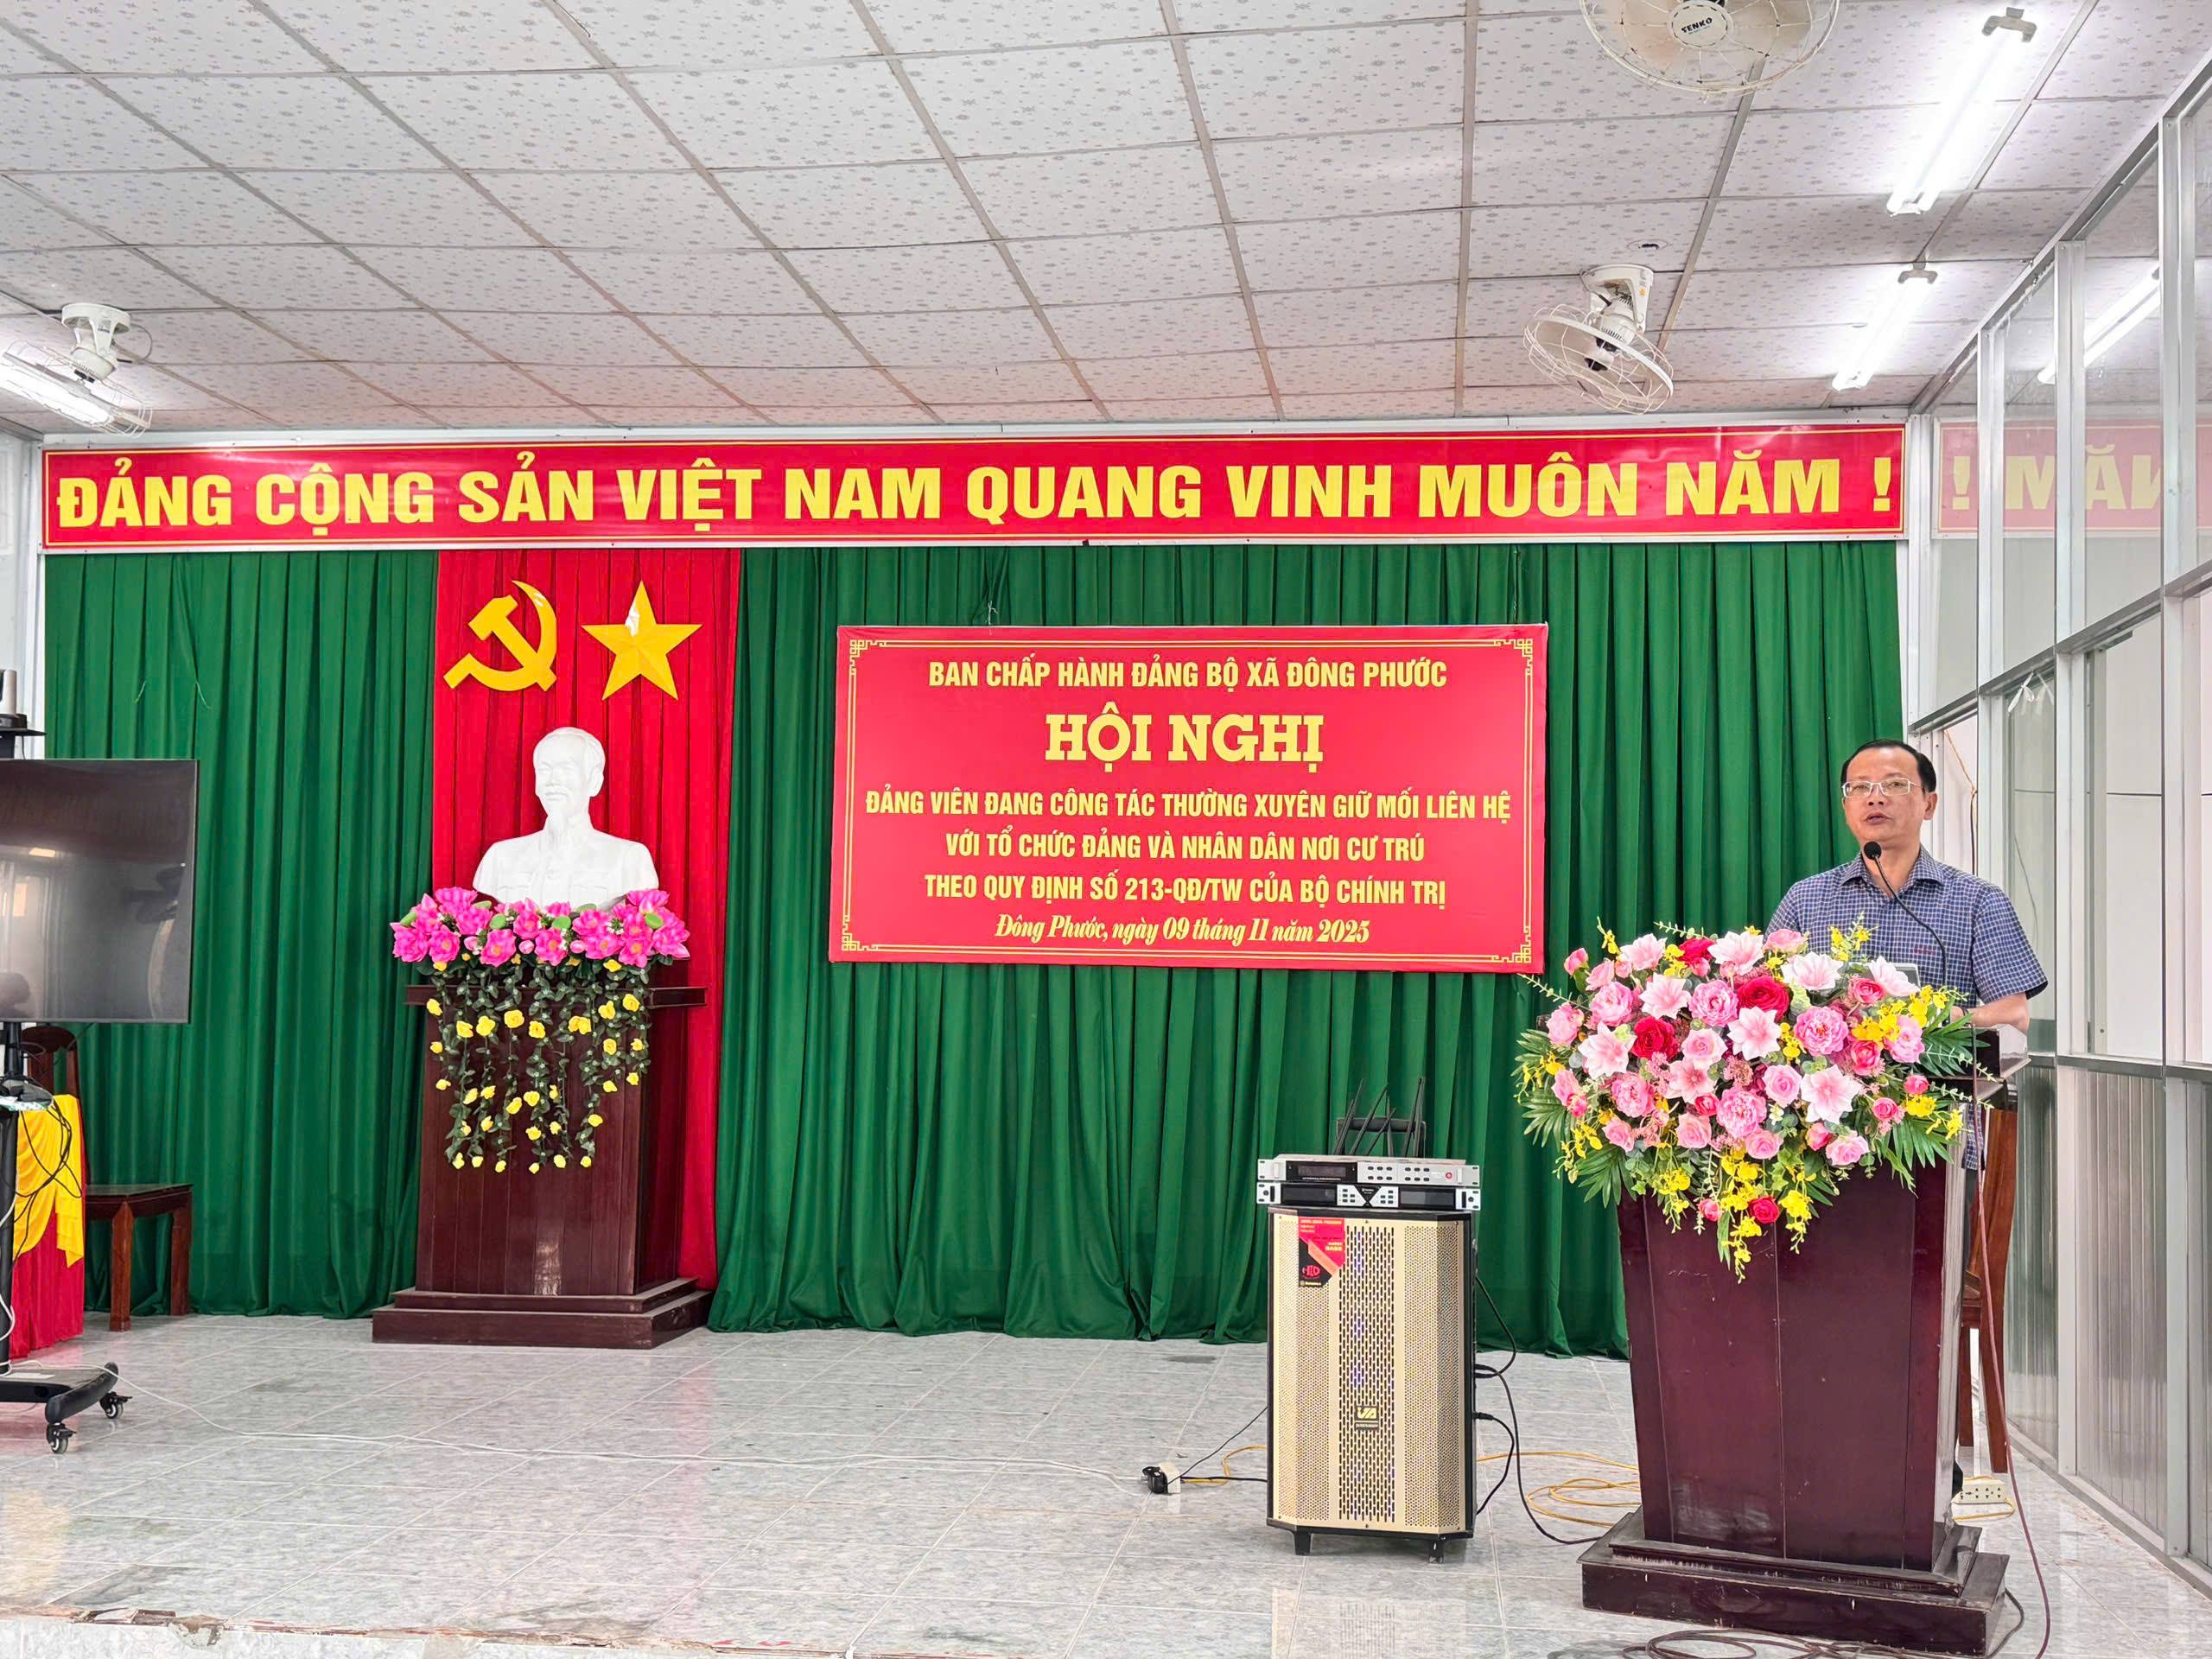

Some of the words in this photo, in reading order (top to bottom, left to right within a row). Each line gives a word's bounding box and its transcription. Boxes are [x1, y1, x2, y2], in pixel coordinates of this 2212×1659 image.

[57, 456, 232, 527] ĐẢNG
[256, 464, 434, 537] CỘNG
[458, 451, 594, 523] SẢN
[617, 457, 762, 532] VIỆT
[785, 467, 941, 519] NAM
[967, 466, 1201, 525] QUANG
[1226, 465, 1392, 518] VINH
[1419, 451, 1638, 518] MUÔN
[1665, 449, 1840, 516] NĂM
[1873, 457, 1891, 512] !
[930, 662, 979, 686] BAN
[987, 655, 1051, 687] CHẤP
[1058, 658, 1124, 687] HÀNH
[1131, 655, 1198, 688] ĐẢNG
[1207, 657, 1239, 693] BỘ
[1247, 658, 1281, 687] XÃ
[1287, 658, 1356, 688] ĐÔNG
[1363, 656, 1447, 688] PHƯỚC
[1045, 702, 1153, 773] HỘI
[1167, 713, 1325, 774] NGHỊ
[866, 786, 925, 815] ĐẢNG
[931, 787, 979, 815] VIÊN
[985, 791, 1044, 816] ĐANG
[1051, 788, 1109, 817] CÔNG
[1116, 788, 1155, 817] TÁC
[1162, 788, 1248, 817] THƯỜNG
[1255, 790, 1326, 818] XUYÊN
[1333, 790, 1373, 819] GIỮ
[1377, 787, 1420, 819] MỐI
[1427, 790, 1476, 819] LIÊN
[1483, 790, 1512, 824] HỆ
[946, 829, 980, 856] VỚI
[987, 825, 1013, 857] TỔ
[1019, 830, 1076, 858] CHỨC
[1082, 830, 1141, 859] ĐẢNG
[1147, 830, 1176, 859] VÀ
[1182, 830, 1243, 860] NHÂN
[1250, 831, 1295, 861] DÂN
[1302, 834, 1340, 861] NƠI
[1347, 835, 1380, 861] CƯ
[1382, 833, 1425, 862] TRÚ
[925, 874, 977, 899] THEO
[984, 875, 1026, 901] QUY
[1032, 876, 1084, 905] ĐỊNH
[1090, 869, 1120, 900] SỐ
[1125, 877, 1243, 904] 213-QĐ/TW
[1250, 871, 1294, 903] CỦA
[1300, 874, 1330, 909] BỘ
[1337, 875, 1405, 905] CHÍNH
[1411, 880, 1446, 910] TRỊ
[995, 913, 1046, 944] Đông
[1046, 914, 1109, 942] Phước,
[1111, 917, 1160, 945] ngày
[1162, 916, 1190, 940] 09
[1192, 917, 1247, 947] tháng
[1248, 918, 1269, 941] 11
[1271, 919, 1314, 942] năm
[1316, 918, 1370, 943] 2025
